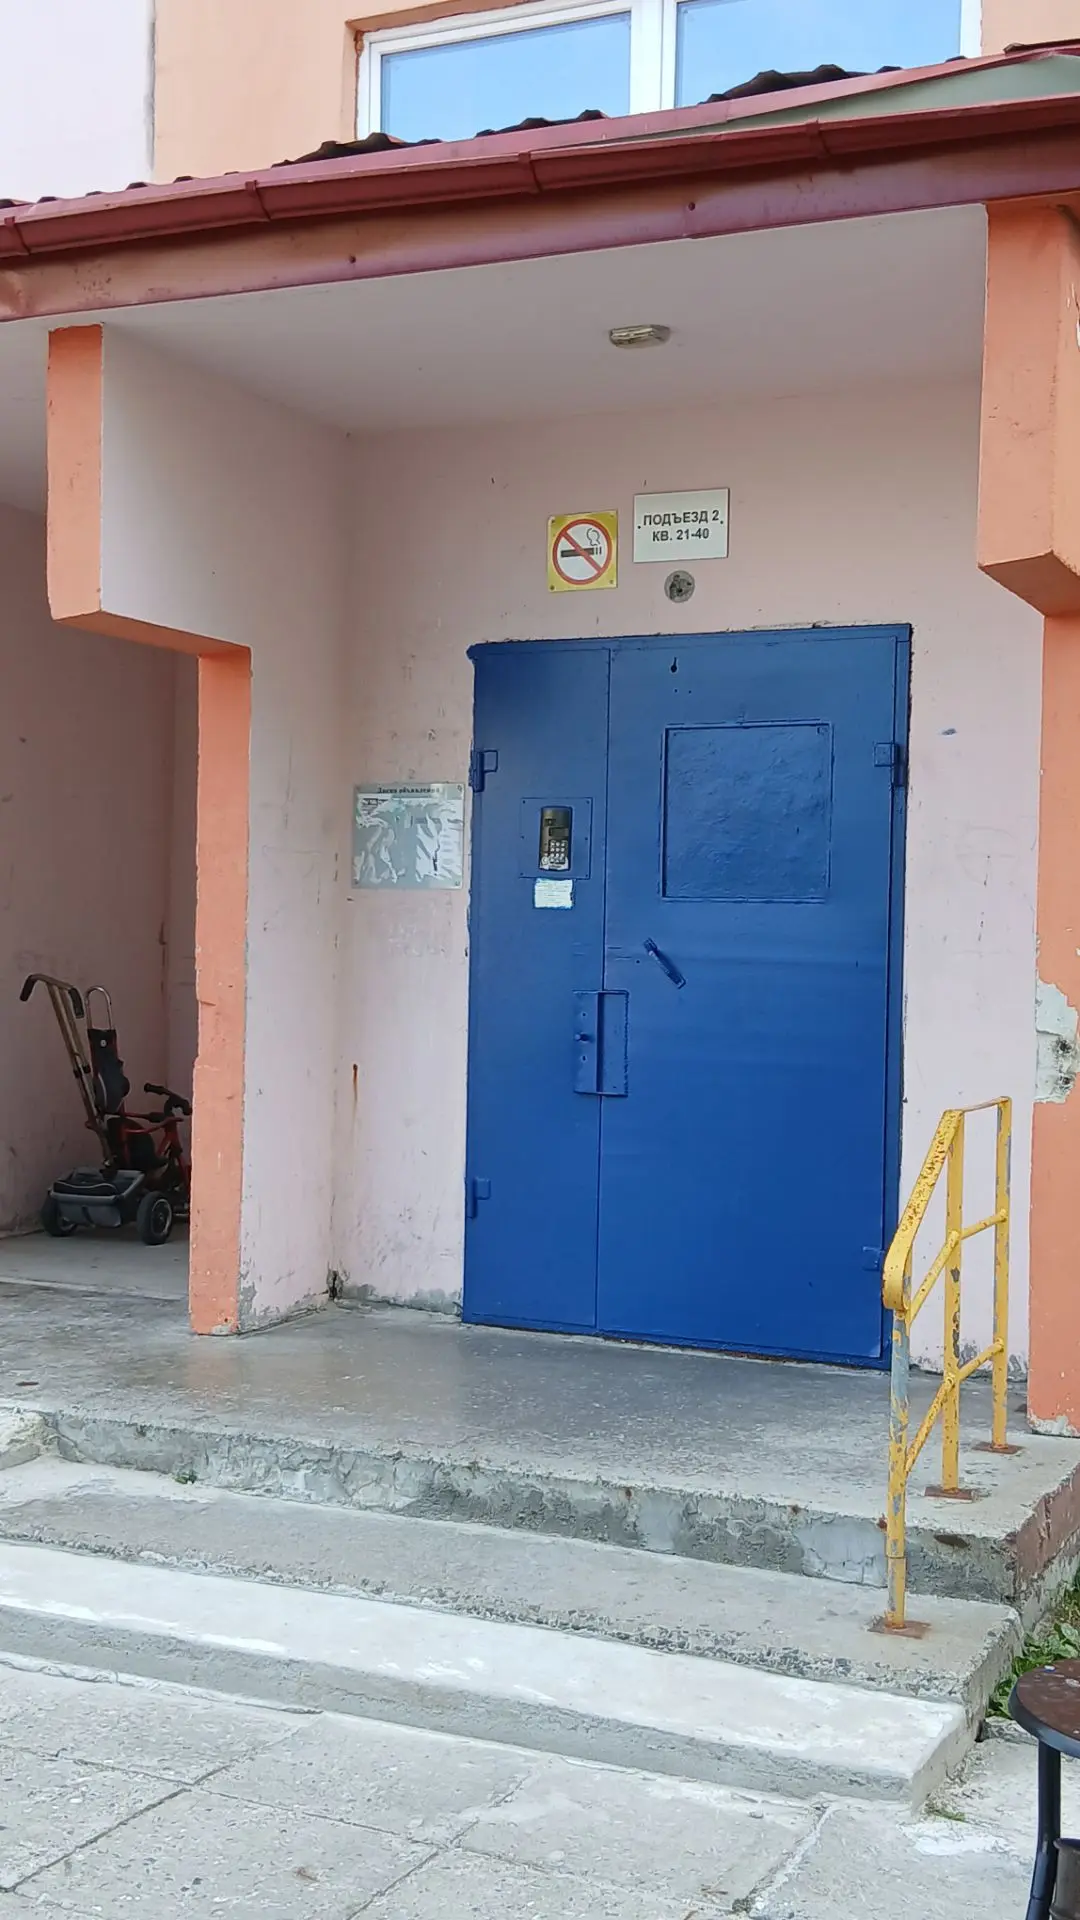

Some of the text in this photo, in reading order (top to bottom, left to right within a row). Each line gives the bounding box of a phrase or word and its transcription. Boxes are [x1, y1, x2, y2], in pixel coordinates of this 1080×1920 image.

[643, 509, 720, 526] ПОДЪЕЗД 2
[652, 527, 710, 542] КВ. 21-40
